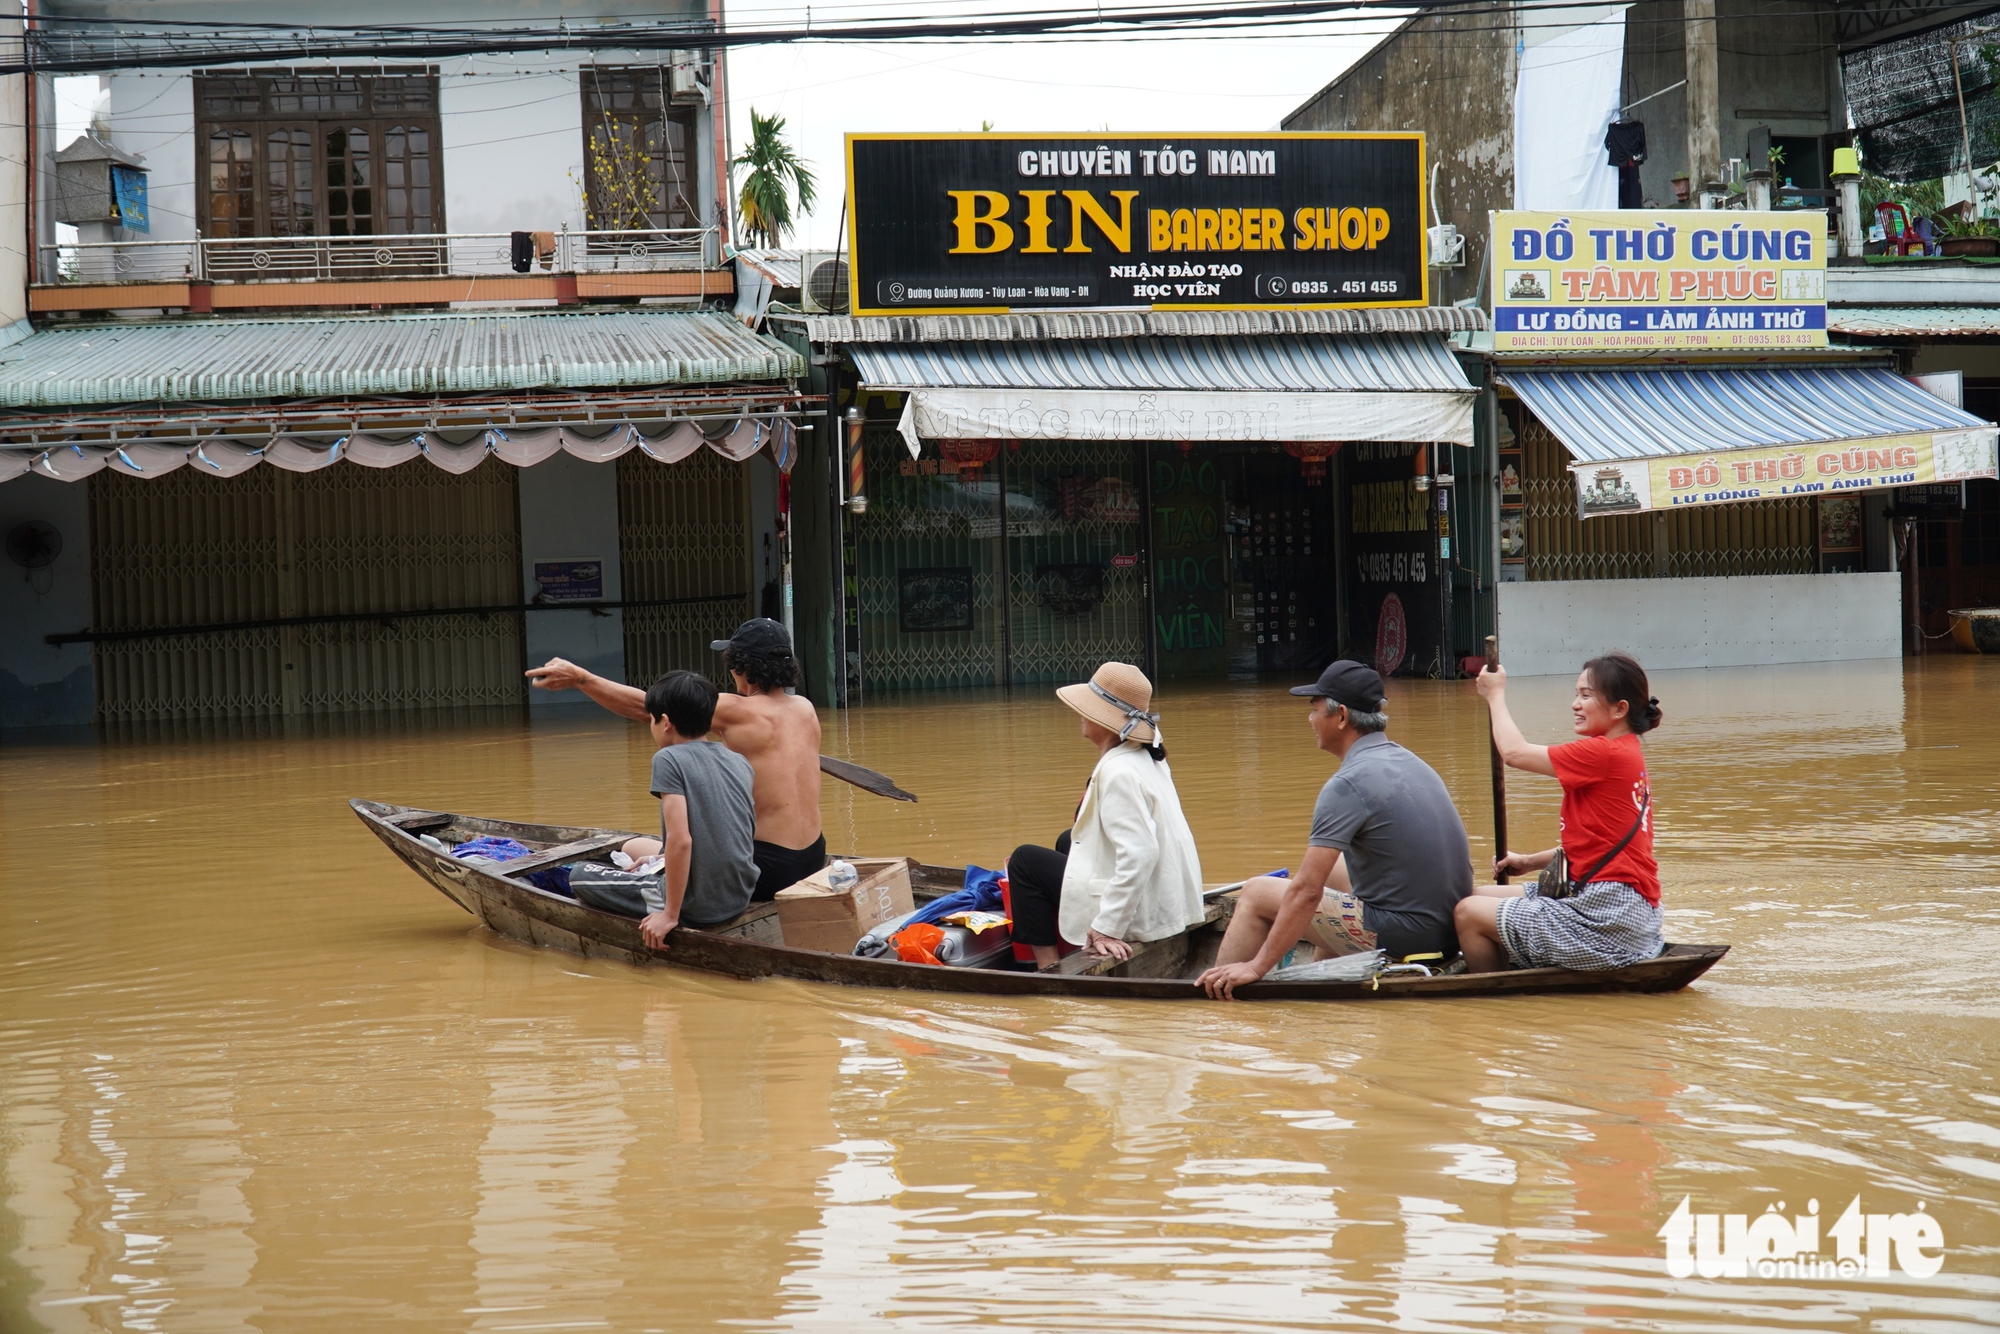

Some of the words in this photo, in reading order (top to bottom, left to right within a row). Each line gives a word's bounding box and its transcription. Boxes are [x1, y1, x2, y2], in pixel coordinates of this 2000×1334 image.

[1018, 145, 1132, 176] CHUYÊN
[1140, 144, 1197, 176] TÓC
[1208, 149, 1276, 176] NAM
[947, 190, 1140, 254] BIN
[1148, 207, 1286, 252] BARBER
[1294, 206, 1391, 251] SHOP
[1512, 218, 1574, 261] ĐỒ
[1589, 221, 1677, 261] THỜ
[1692, 223, 1811, 261] CÚNG
[1109, 262, 1164, 280] NHẬN
[1167, 261, 1206, 277] ĐÀO
[1207, 264, 1243, 279] TẠO
[1292, 281, 1328, 294] 0935
[1342, 281, 1366, 293] 451
[1370, 280, 1398, 293] 455
[1562, 265, 1659, 300] TÂM
[1669, 265, 1777, 300] PHÚC
[907, 286, 932, 299] Đường
[934, 286, 958, 299] Quảng
[960, 287, 984, 299] Xương
[1008, 287, 1026, 298] Loan
[1051, 287, 1070, 298] Vang
[1078, 286, 1089, 297] ĐN
[1133, 283, 1171, 300] HỌC
[1173, 281, 1221, 296] VIÊN
[1517, 311, 1550, 330] LƯ
[1554, 308, 1622, 330] ĐỒNG
[1646, 310, 1698, 330] LÀM
[1705, 307, 1754, 329] ẢNH
[1761, 308, 1806, 329] THỜ
[1512, 336, 1527, 348] ĐỊA
[1571, 336, 1594, 346] LOAN
[1625, 336, 1655, 346] PHONG
[1664, 336, 1676, 345] HV
[1686, 335, 1709, 345] TPĐN
[1732, 335, 1746, 344] ĐT:
[1748, 335, 1772, 344] 0935.
[1775, 335, 1793, 344] 183.
[1796, 335, 1812, 344] 433
[979, 399, 1070, 440] TÓC
[1081, 394, 1194, 441] MIỄN
[1205, 402, 1280, 441] PHÍ
[919, 456, 938, 475] TÓC
[1668, 457, 1721, 490] ĐỒ
[1731, 453, 1806, 484] THỜ
[1816, 446, 1918, 476] CÚNG
[1673, 493, 1699, 505] LƯ
[1781, 483, 1824, 495] LÀM
[1878, 472, 1916, 484] THỜ
[1909, 485, 1927, 495] 0935
[1929, 485, 1942, 495] 183
[1944, 485, 1958, 495] 433
[1352, 484, 1368, 534] BIN
[1368, 480, 1407, 534] BARBER
[1408, 479, 1430, 532] SHOP
[1155, 505, 1219, 548] TẠO
[1157, 555, 1222, 599] HỌC
[1369, 552, 1391, 582] 0935
[1392, 552, 1408, 582] 451
[1410, 552, 1427, 582] 455
[1156, 602, 1225, 650] VIÊN
[874, 886, 897, 922] AQU
